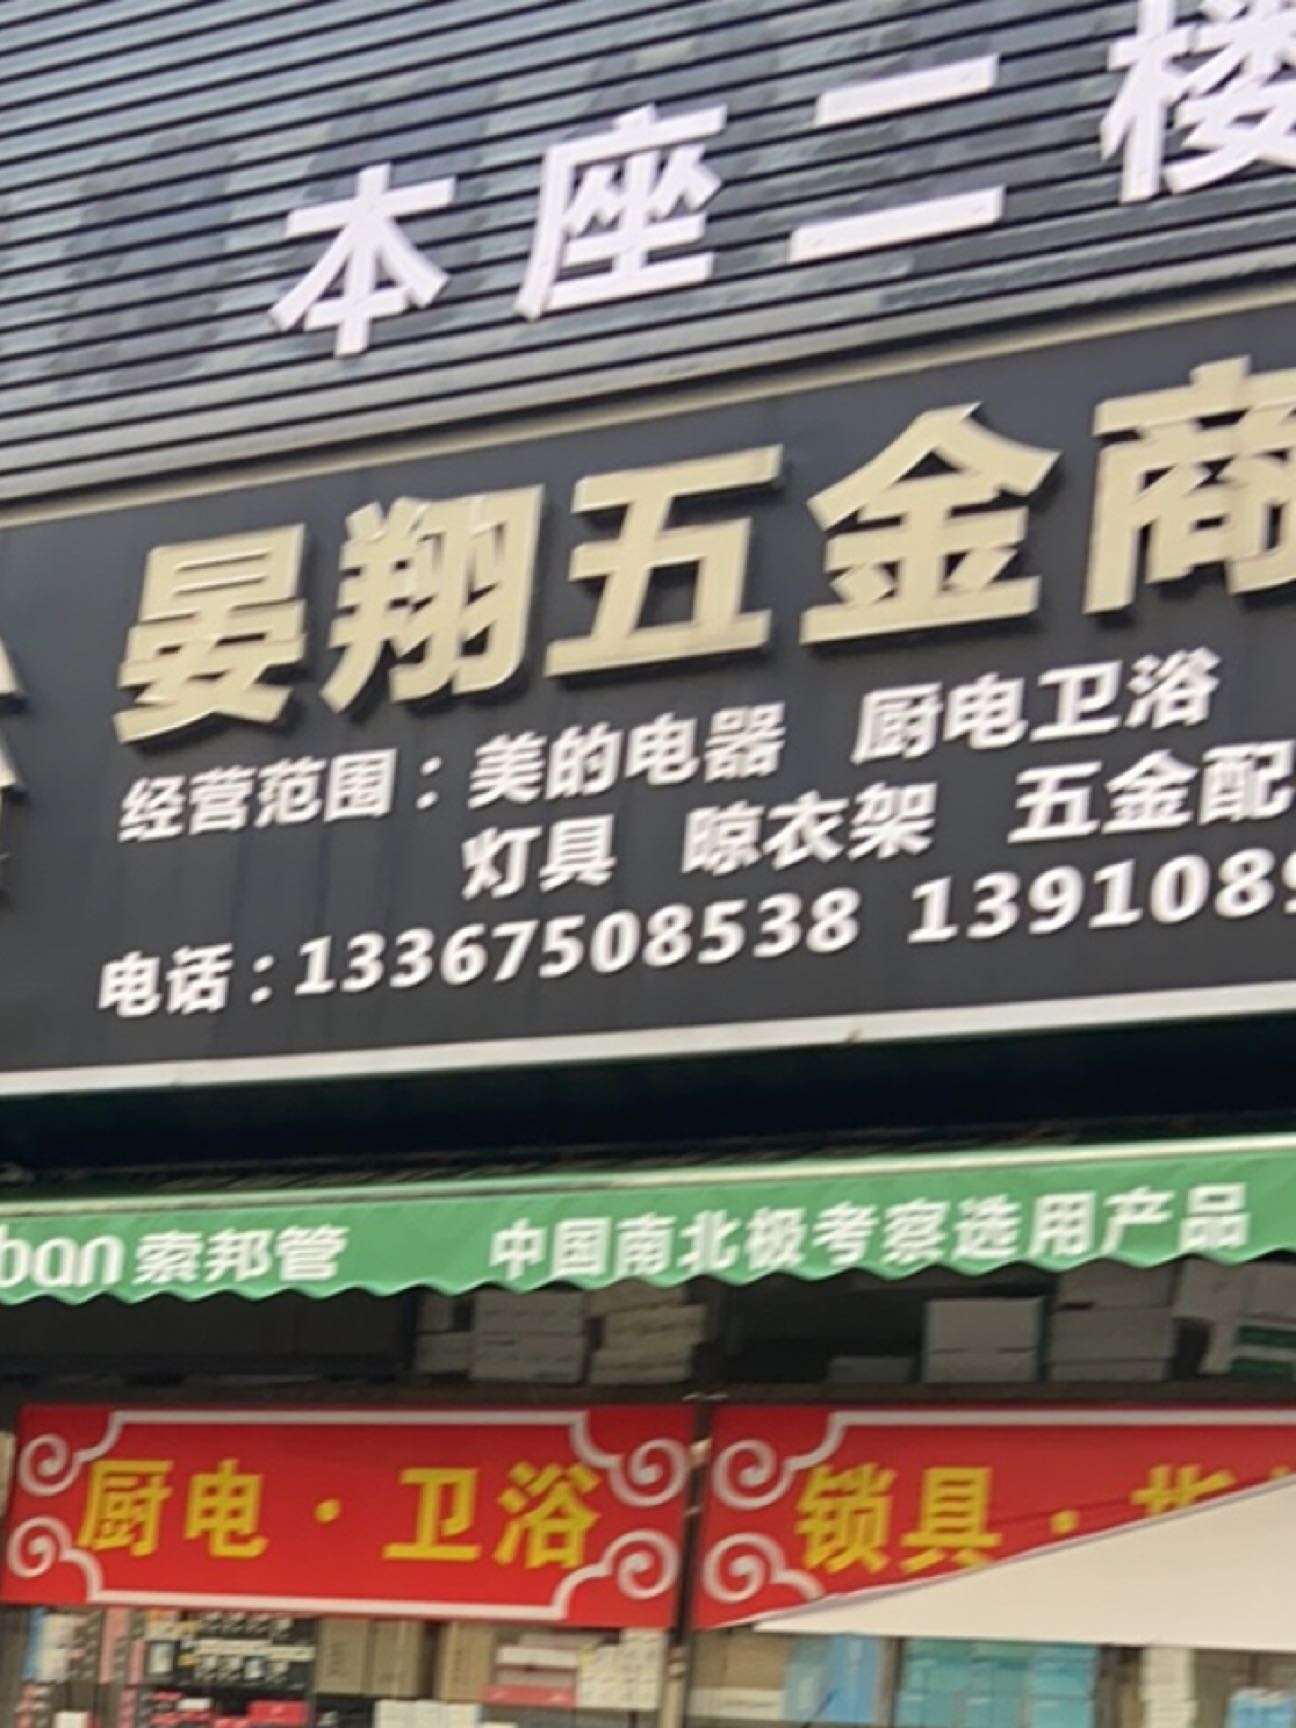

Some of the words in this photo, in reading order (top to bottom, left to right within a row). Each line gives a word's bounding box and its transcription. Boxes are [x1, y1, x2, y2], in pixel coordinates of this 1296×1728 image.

[269, 0, 1296, 359] 本座二楼
[112, 357, 1296, 745] 晏翔五金商
[852, 647, 1221, 765] 厨电卫浴
[461, 814, 616, 900] 灯具
[681, 781, 938, 878] 晾衣架
[1007, 741, 1296, 843] 五金配
[132, 1224, 350, 1285] 索邦管
[488, 1182, 1250, 1281] 中国南北极考察选用产品
